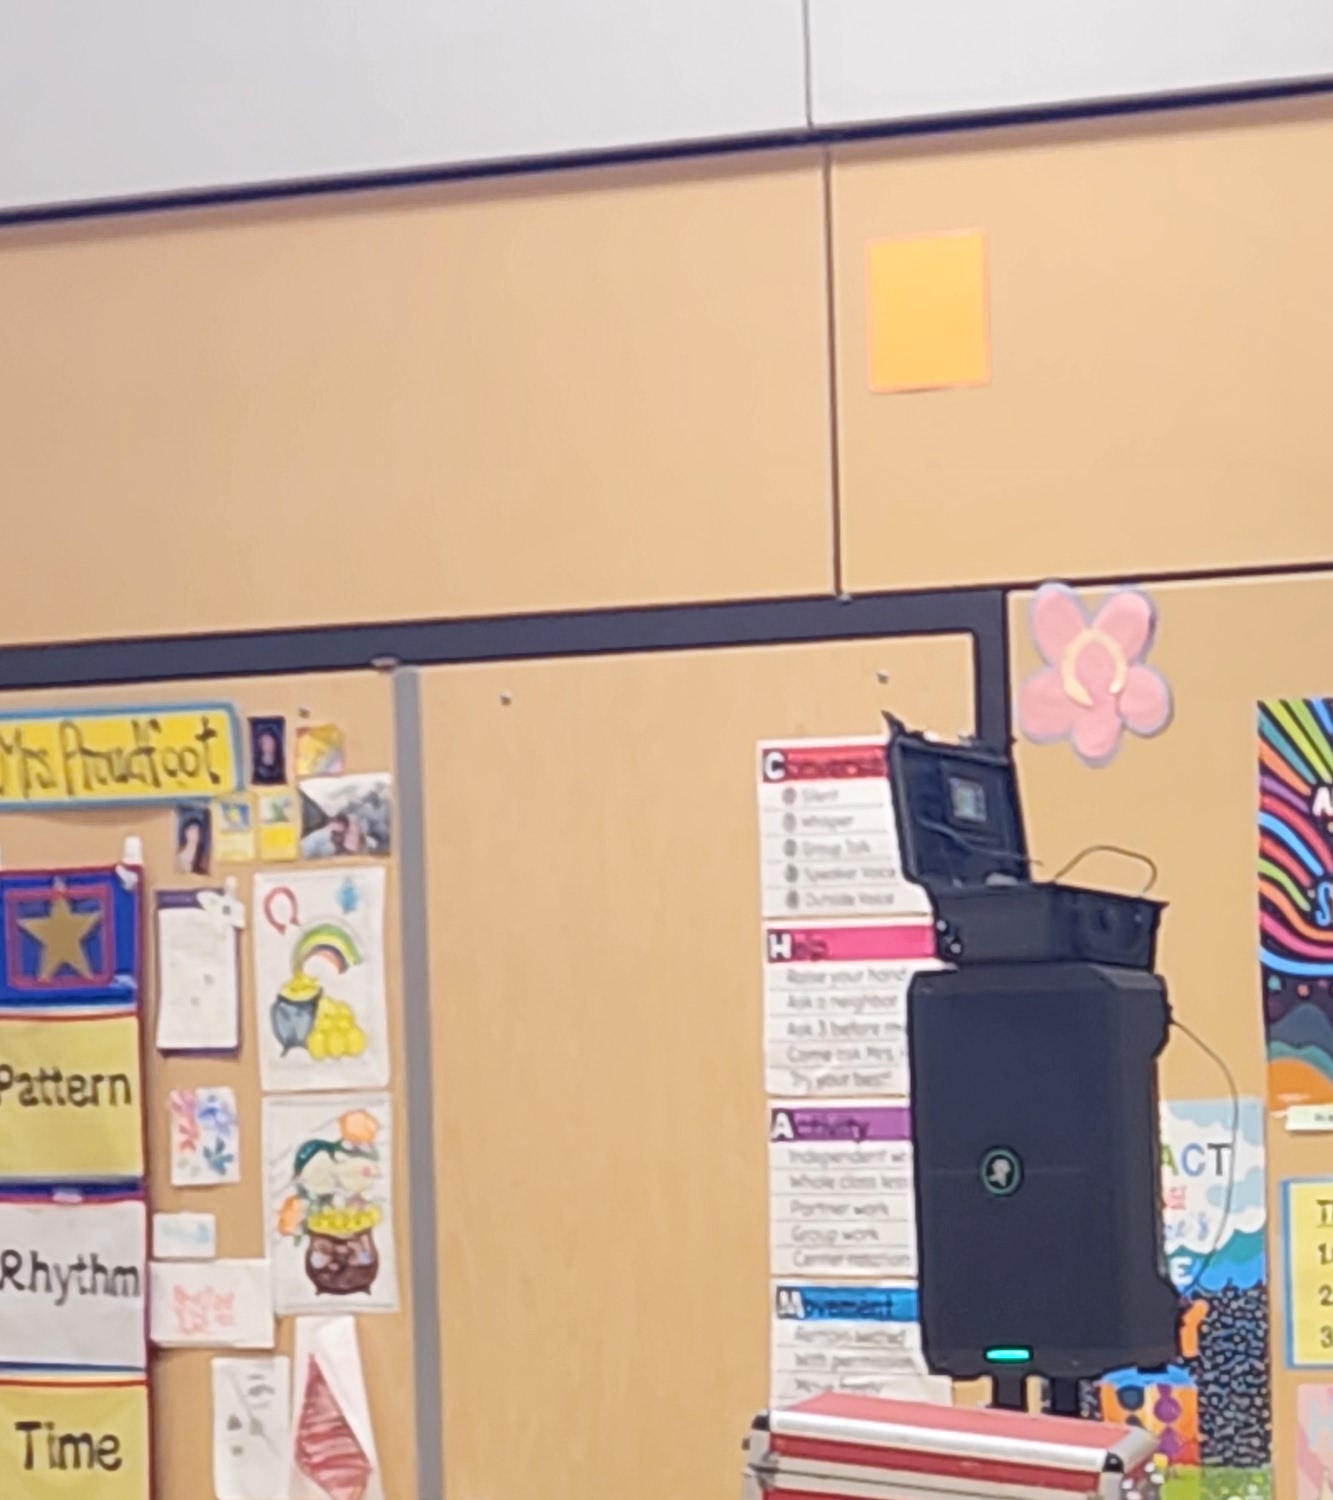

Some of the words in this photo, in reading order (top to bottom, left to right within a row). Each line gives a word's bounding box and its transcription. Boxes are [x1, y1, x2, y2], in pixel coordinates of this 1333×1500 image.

[0, 1063, 131, 1107] Pattern
[0, 1247, 140, 1306] Rhythm
[14, 1419, 123, 1472] Time
